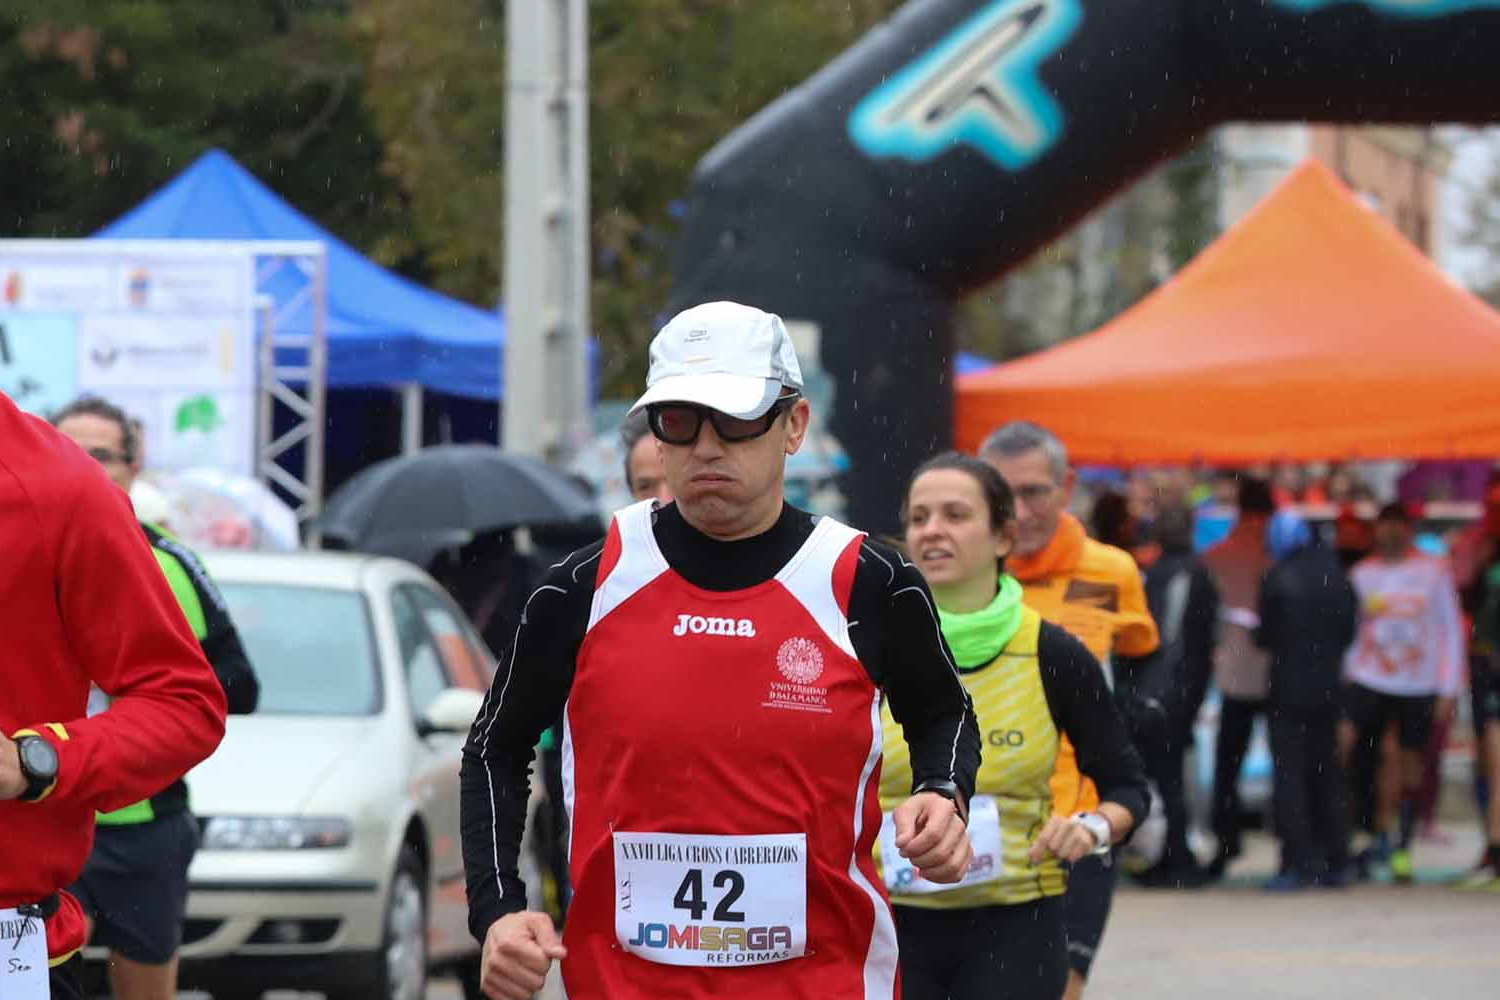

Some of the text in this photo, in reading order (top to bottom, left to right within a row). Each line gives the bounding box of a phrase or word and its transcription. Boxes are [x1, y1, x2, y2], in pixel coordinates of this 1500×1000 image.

[621, 843, 799, 865] XXVII LIGA CROSS CABRERIZOS
[673, 869, 745, 922] 42
[629, 922, 792, 951] JOMISAGA
[707, 951, 789, 963] REFORMAS
